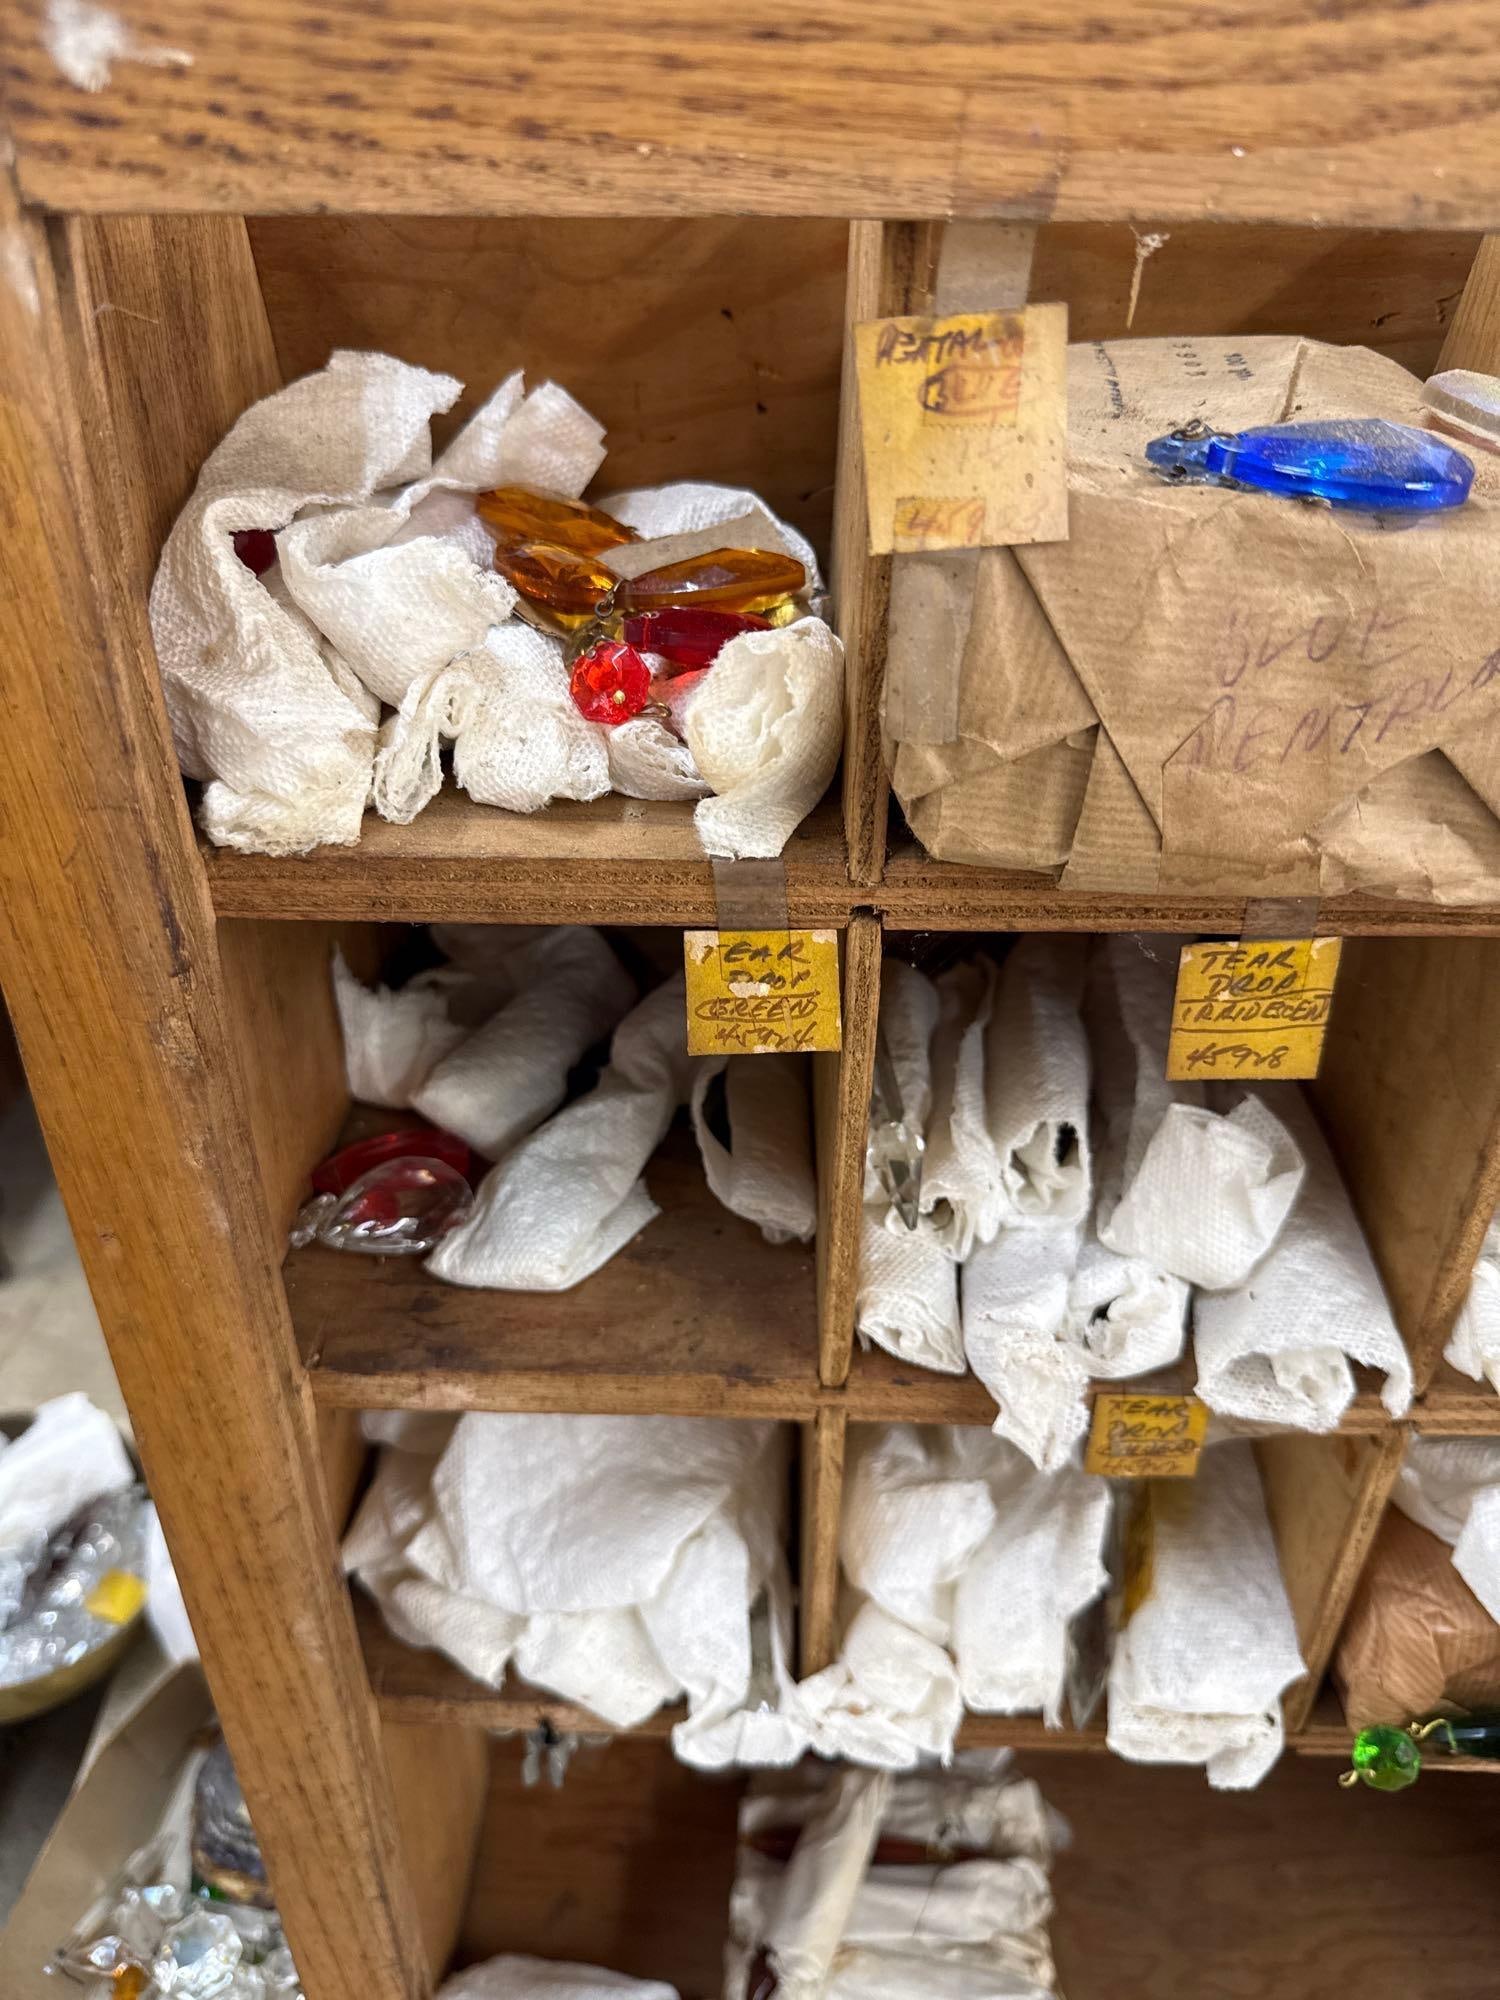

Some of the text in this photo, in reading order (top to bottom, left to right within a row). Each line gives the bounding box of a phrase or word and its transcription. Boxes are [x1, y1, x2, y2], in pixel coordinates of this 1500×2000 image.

[702, 941, 811, 964] TEAR
[1201, 947, 1297, 975] TEAR
[1206, 970, 1297, 998] DROP
[707, 996, 818, 1019] GREEN
[1107, 1399, 1188, 1417] TEAR
[1107, 1418, 1189, 1439] DROP
